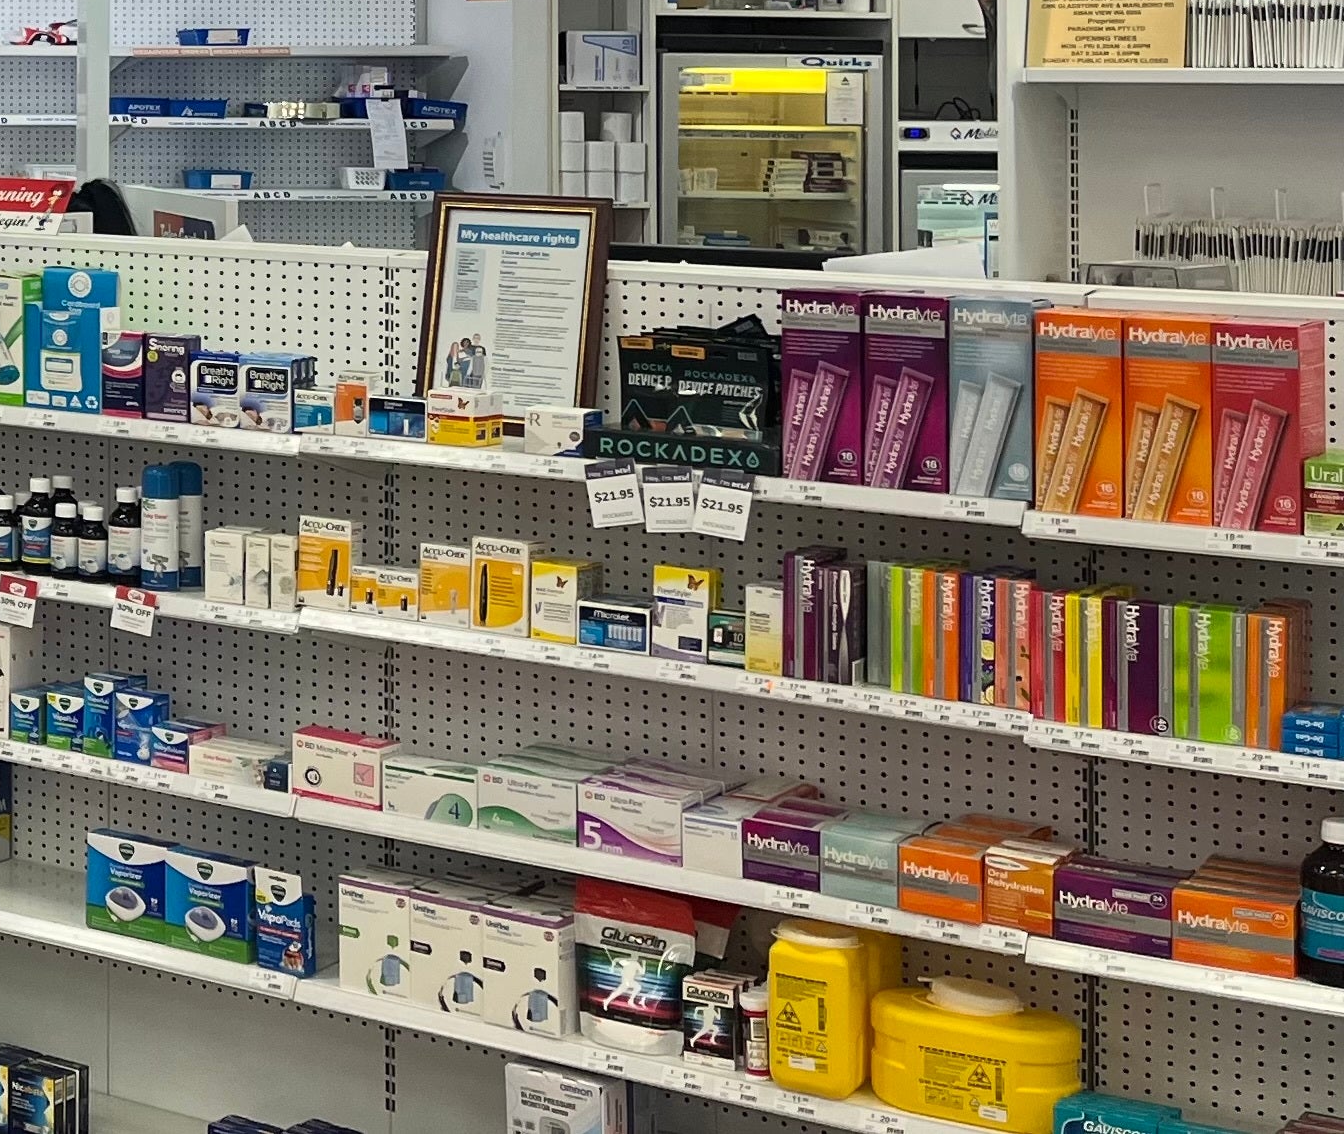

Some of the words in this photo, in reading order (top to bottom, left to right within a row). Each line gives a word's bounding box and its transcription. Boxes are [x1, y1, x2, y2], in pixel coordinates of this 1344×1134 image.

[801, 57, 872, 67] Quirks
[423, 106, 456, 114] APOTEX
[461, 230, 478, 241] My
[482, 231, 539, 242] healthcare
[543, 233, 576, 245] rights
[785, 299, 855, 317] Hydralyte
[869, 304, 940, 322] Hydralyte
[954, 307, 1030, 326] Hydralyte
[1040, 321, 1115, 341] Hydralyte
[1128, 327, 1207, 346] Hydralyte
[1216, 332, 1293, 352] Hydralyte
[201, 366, 234, 376] Breathe
[250, 370, 285, 381] Breathe
[212, 375, 234, 386] Right
[262, 380, 285, 391] Right
[678, 380, 713, 395] DEVICE
[715, 384, 762, 398] PATCHES
[600, 437, 743, 466] ROCKADEX
[1310, 466, 1343, 483] Ural
[594, 489, 634, 503] $21.95
[1100, 483, 1112, 492] 16
[1191, 491, 1203, 500] 16
[649, 497, 690, 507] $21.95
[701, 499, 743, 514] $21.95
[1278, 499, 1291, 509] 16
[17, 601, 32, 611] OFF
[942, 576, 956, 632] Hydralyte
[981, 579, 994, 635] Hydralyte
[135, 608, 152, 619] OFF
[1052, 596, 1065, 652] Hydralyte
[1125, 604, 1140, 662] Hydralyte
[1267, 621, 1282, 678] Hydralyte
[448, 801, 460, 820] 4
[747, 833, 809, 856] Hydralyte
[824, 845, 888, 870] Hydralyte
[903, 861, 969, 885] Hydralyte
[987, 868, 1008, 879] Oral
[987, 877, 1045, 896] Rehydration
[1059, 890, 1128, 915] Hydralyte
[1177, 910, 1249, 934] Hydralyte
[601, 927, 667, 950] Glucodin
[687, 985, 730, 1002] Glucodin
